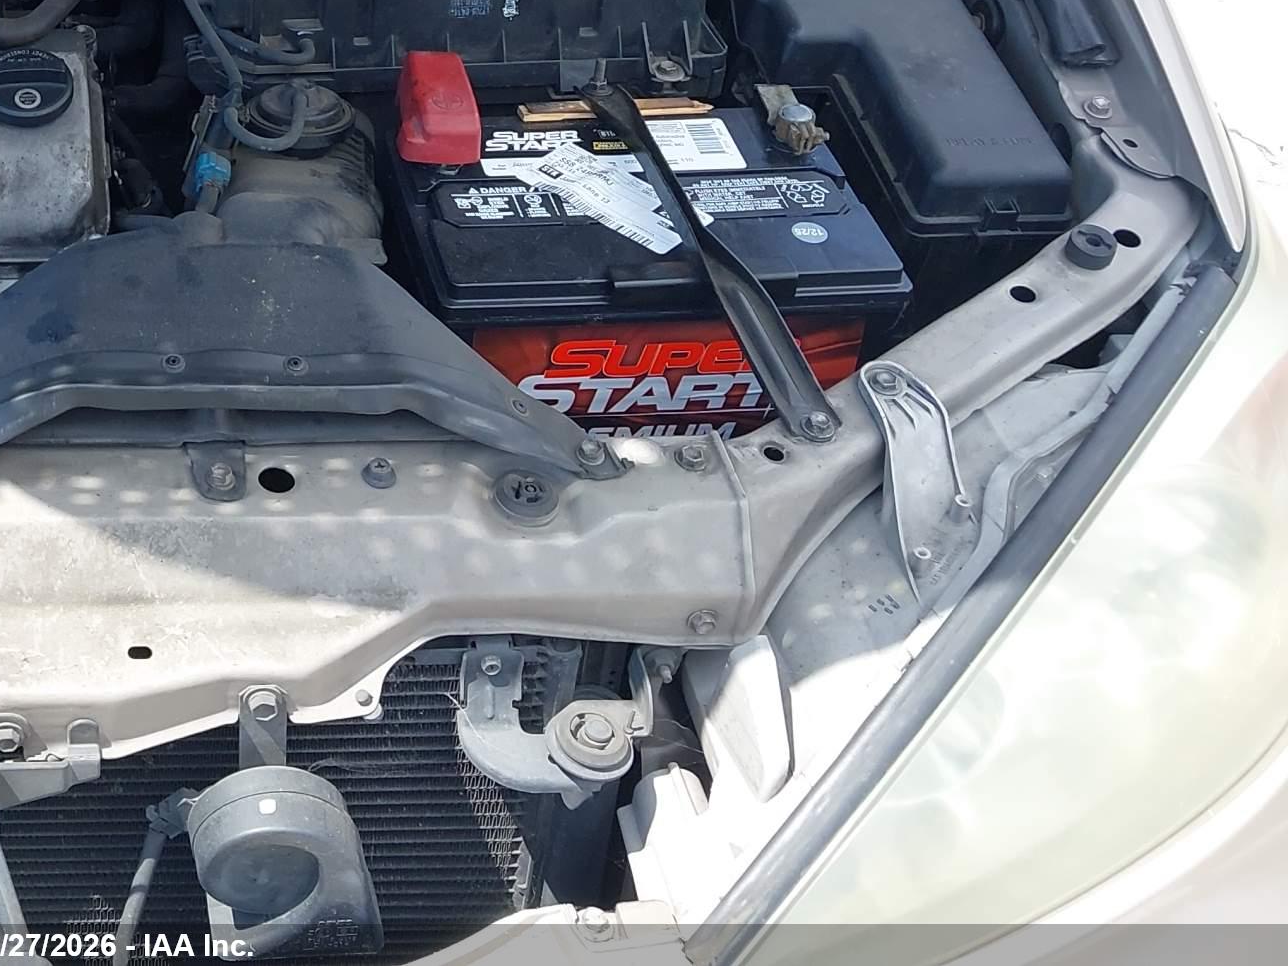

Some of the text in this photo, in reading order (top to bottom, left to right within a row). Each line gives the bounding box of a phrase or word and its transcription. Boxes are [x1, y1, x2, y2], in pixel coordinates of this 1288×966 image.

[492, 130, 580, 142] SUPER
[479, 186, 527, 194] DANGER
[544, 339, 753, 379] SUPE
